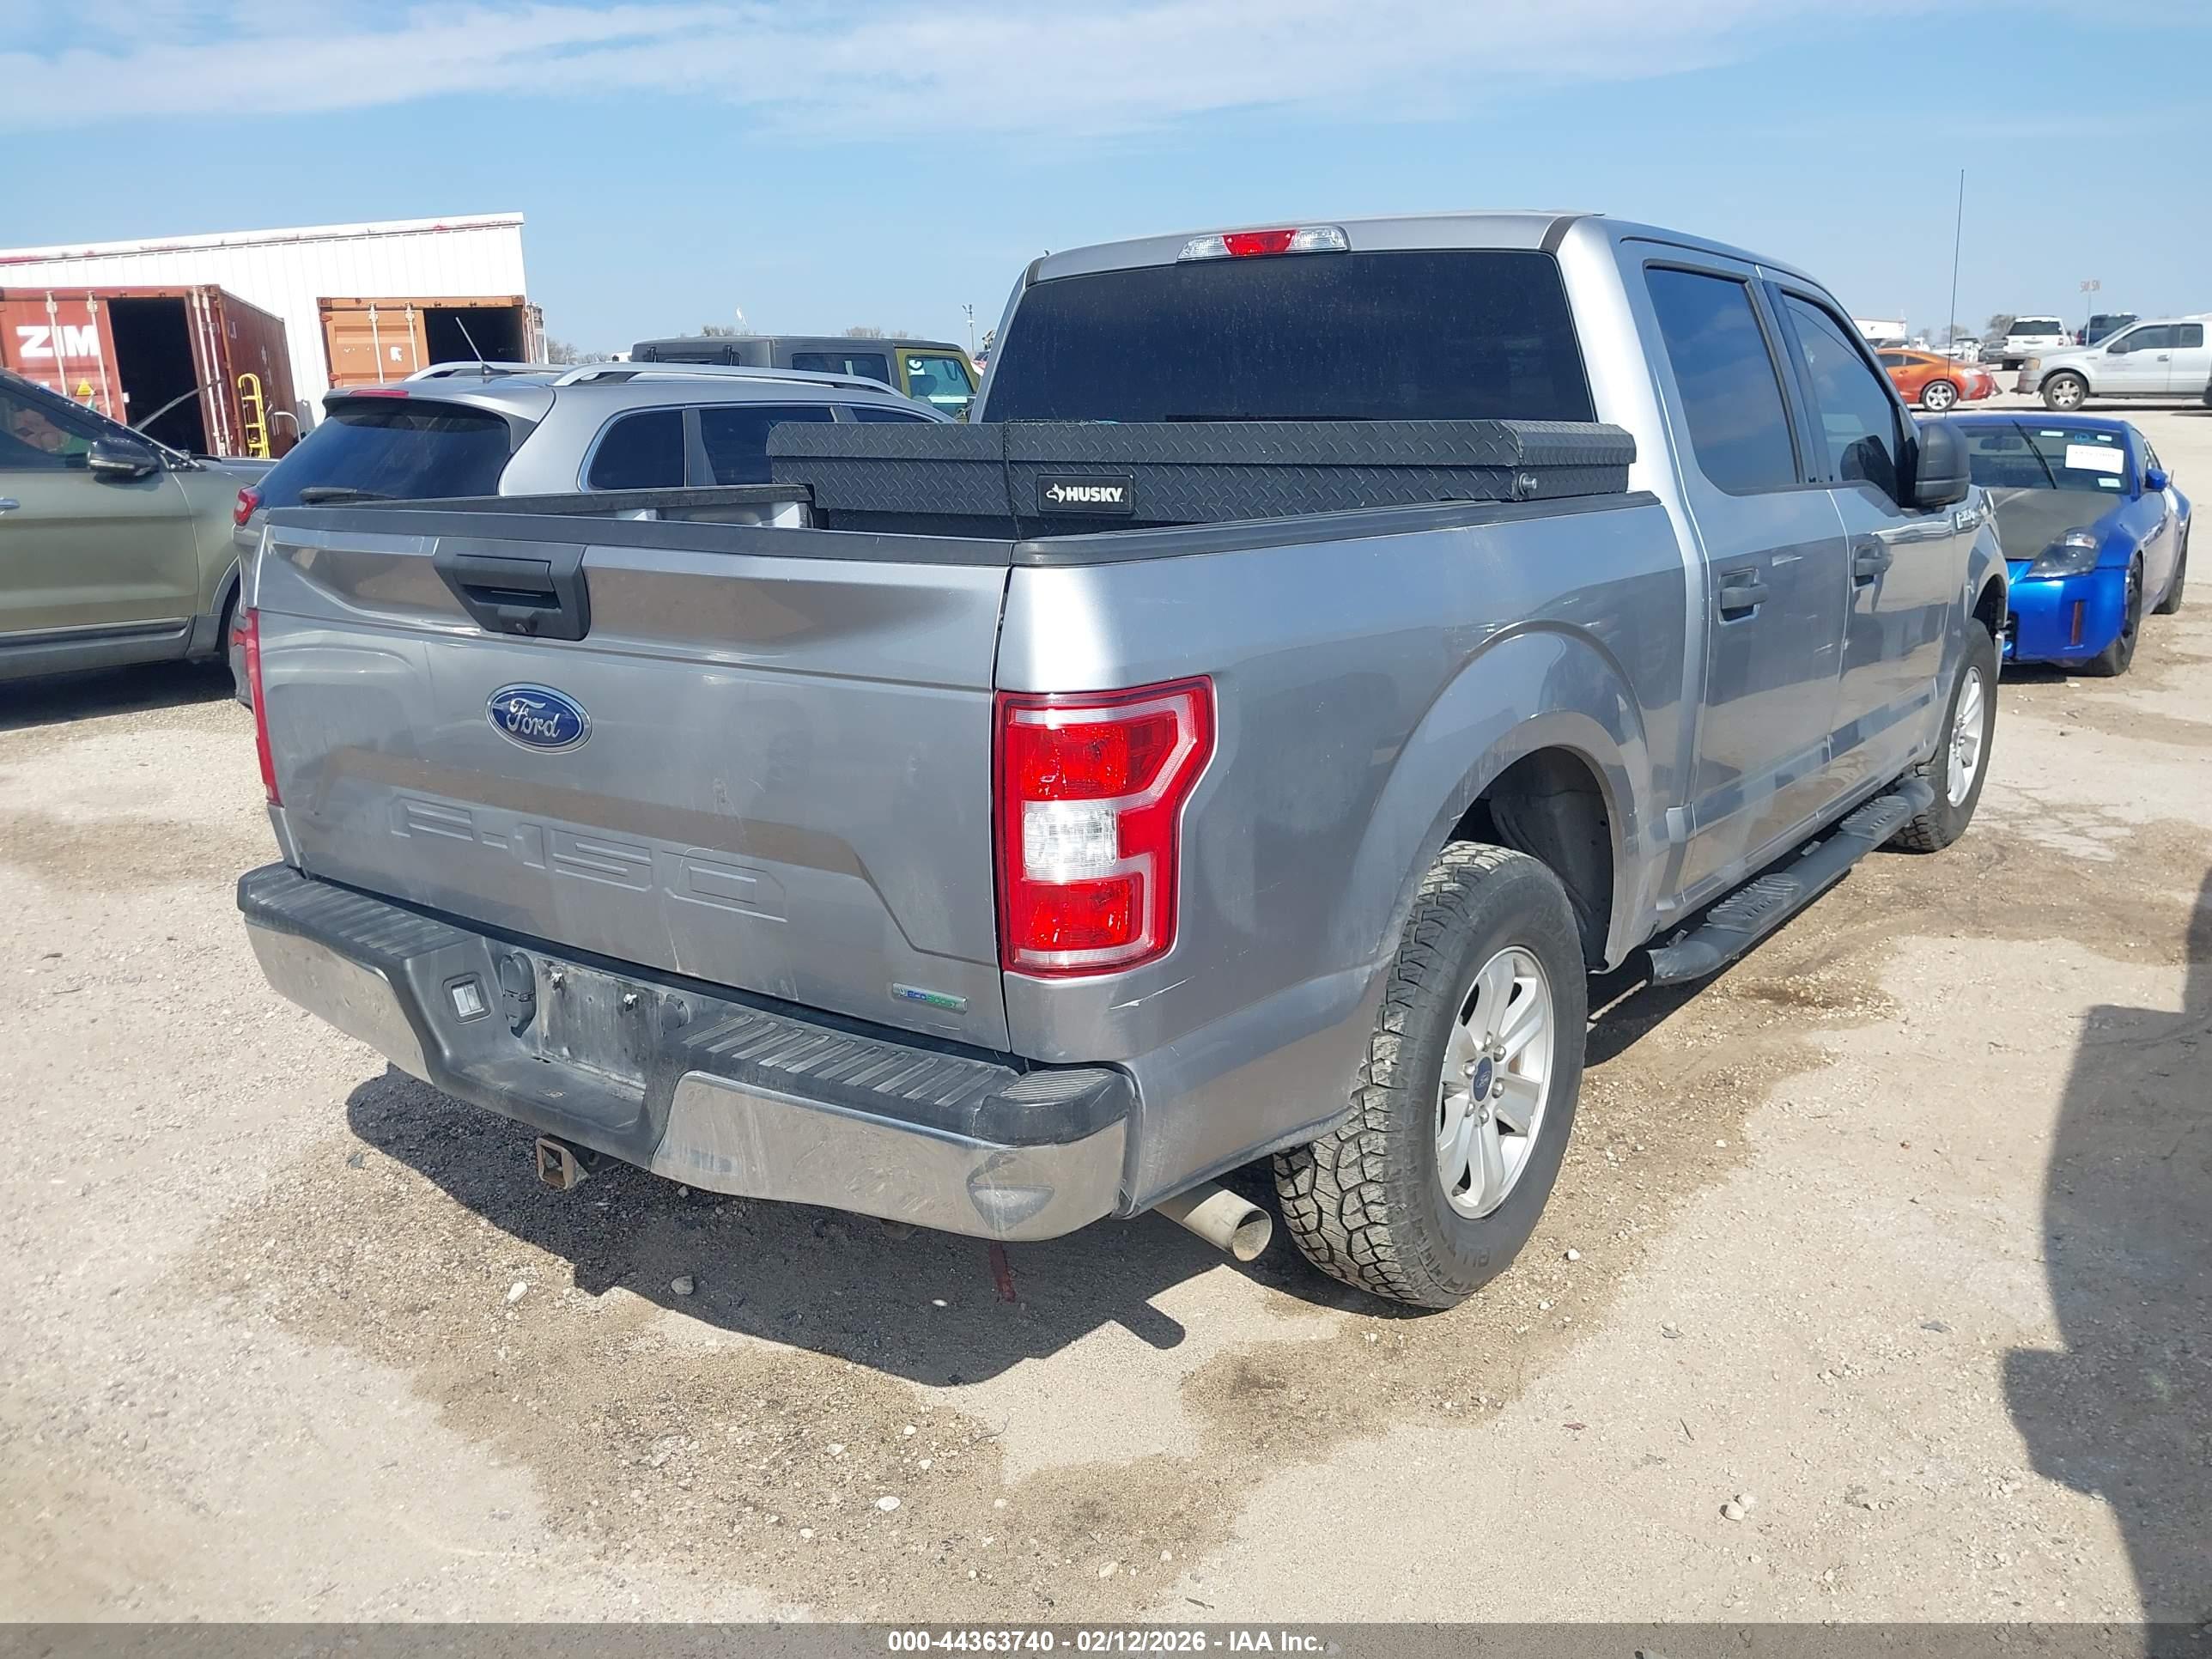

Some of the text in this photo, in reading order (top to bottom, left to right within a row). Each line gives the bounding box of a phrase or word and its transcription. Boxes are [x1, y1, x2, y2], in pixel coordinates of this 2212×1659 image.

[15, 325, 100, 358] ZIM
[1066, 486, 1123, 502] HUSKY
[506, 697, 561, 738] Ford
[390, 795, 787, 923] F-150
